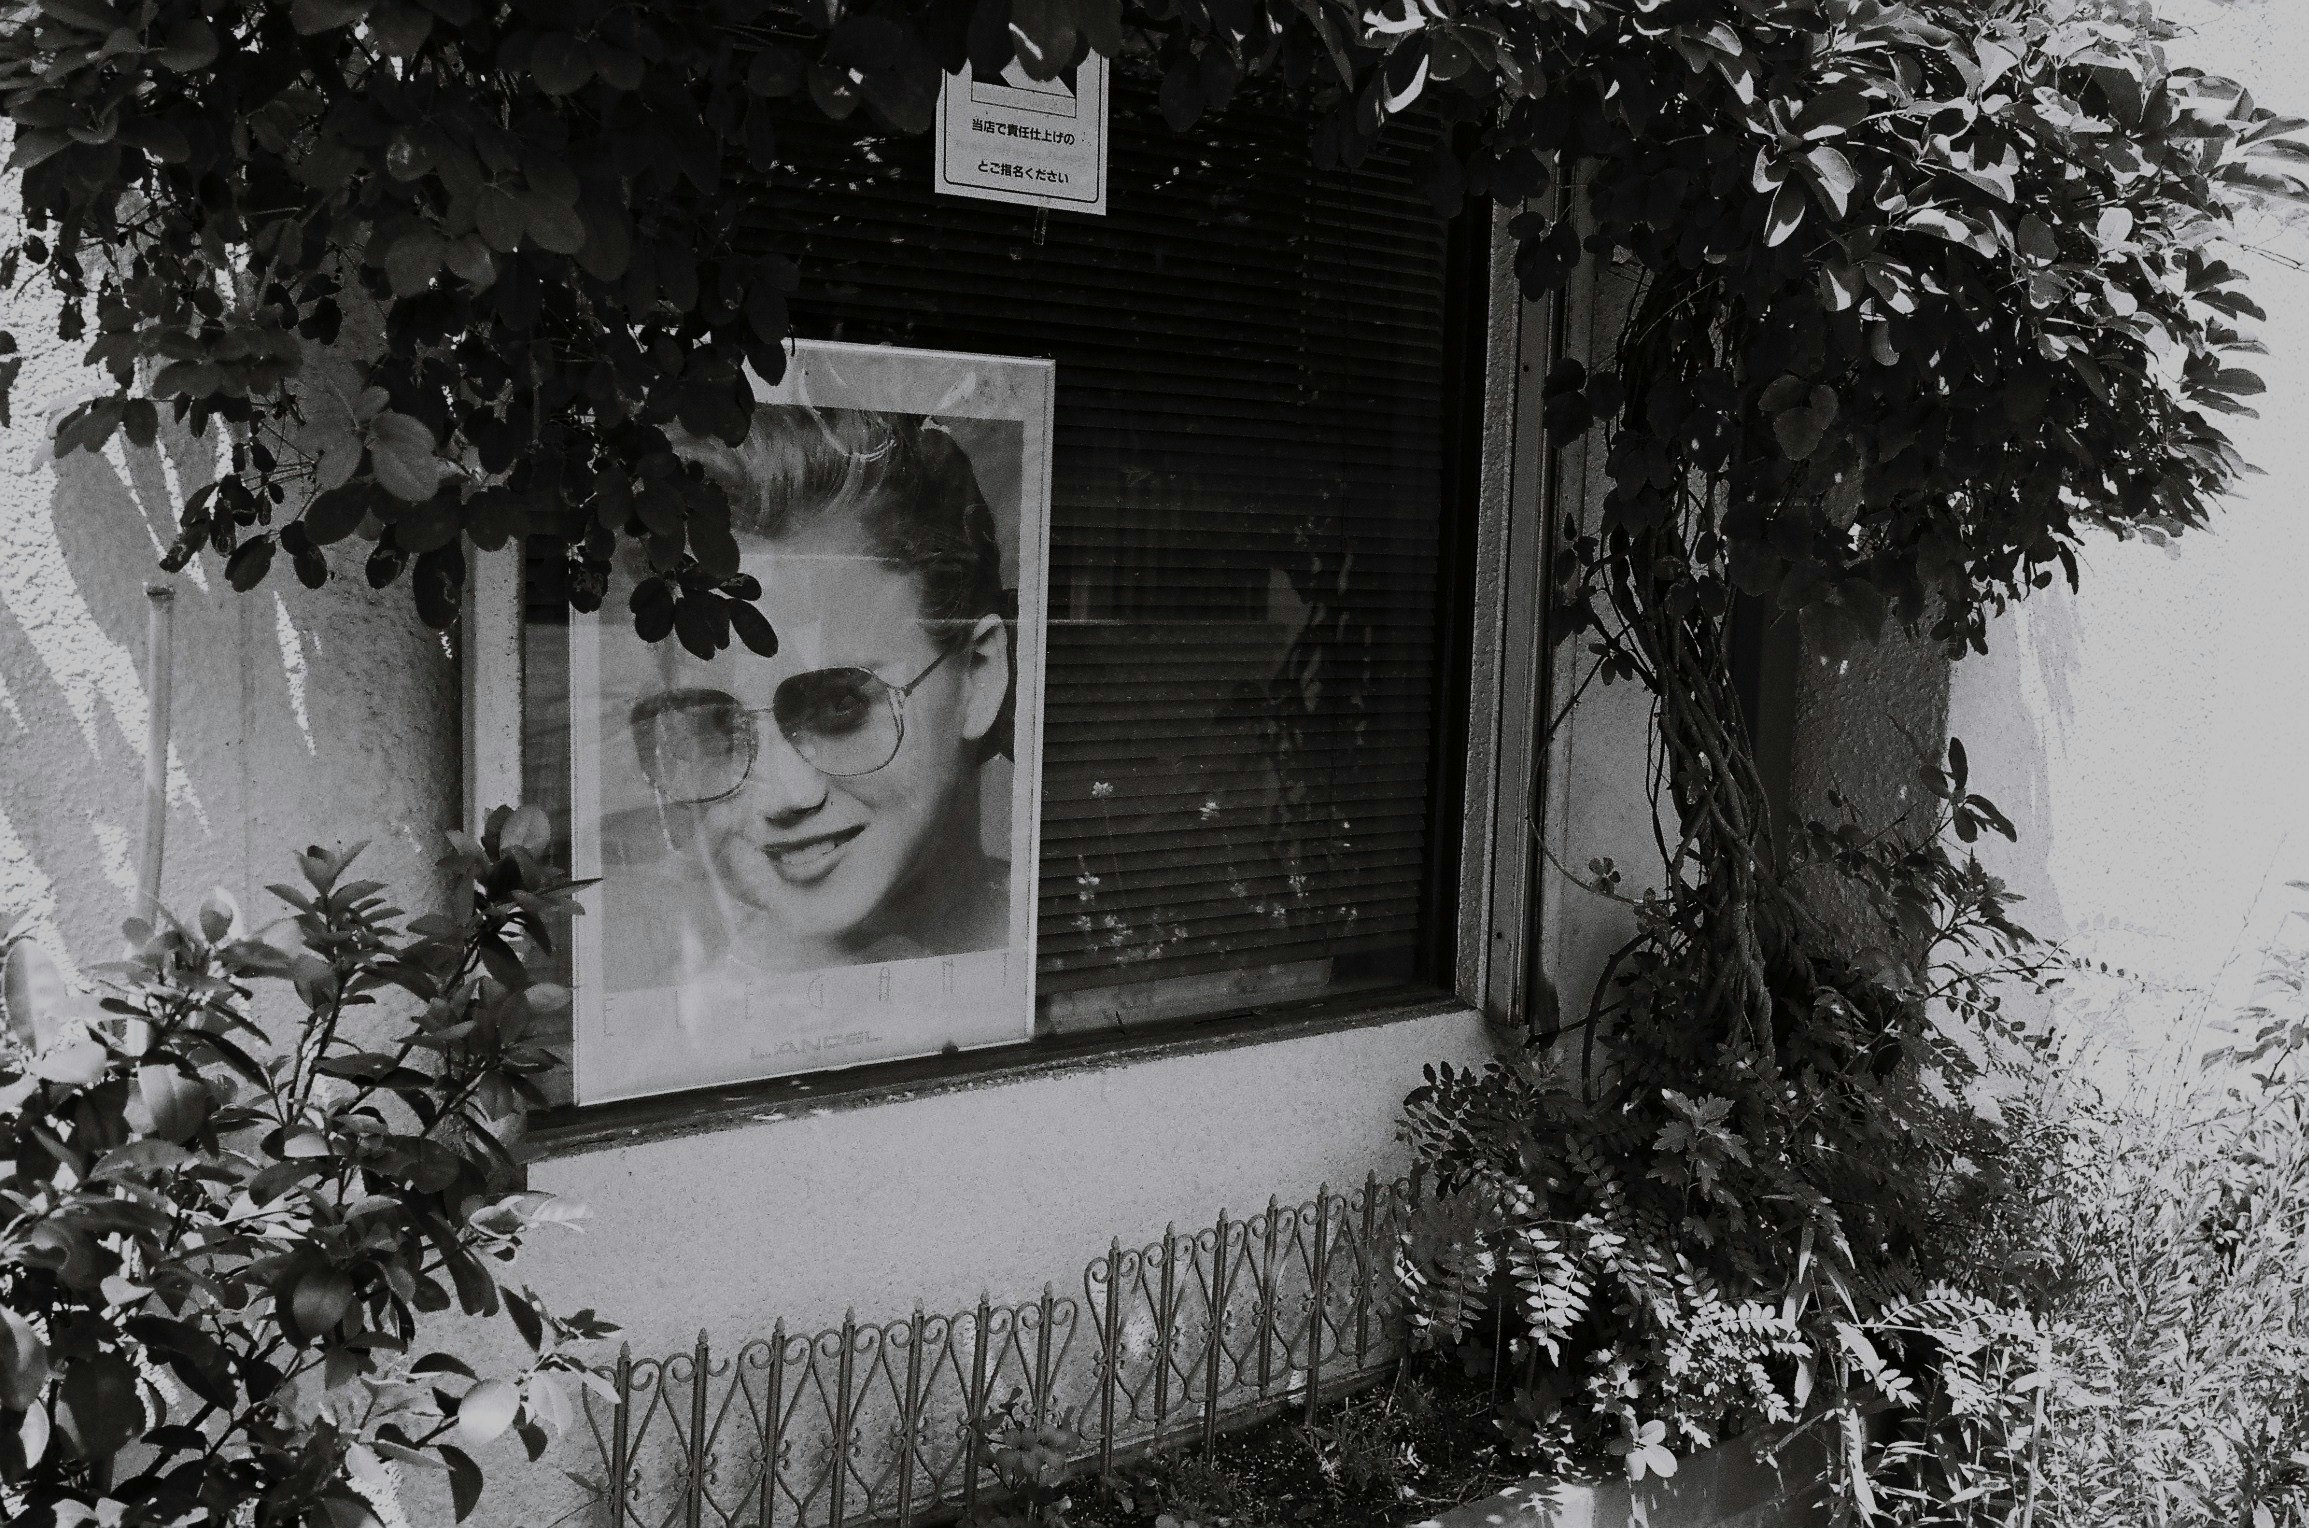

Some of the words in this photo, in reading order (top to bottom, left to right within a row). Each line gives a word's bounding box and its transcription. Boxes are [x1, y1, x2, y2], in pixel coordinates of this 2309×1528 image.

[971, 118, 1075, 146] 当店で責任仕上げの
[978, 160, 1069, 184] とご指名ください
[750, 1029, 883, 1060] LANCEL
